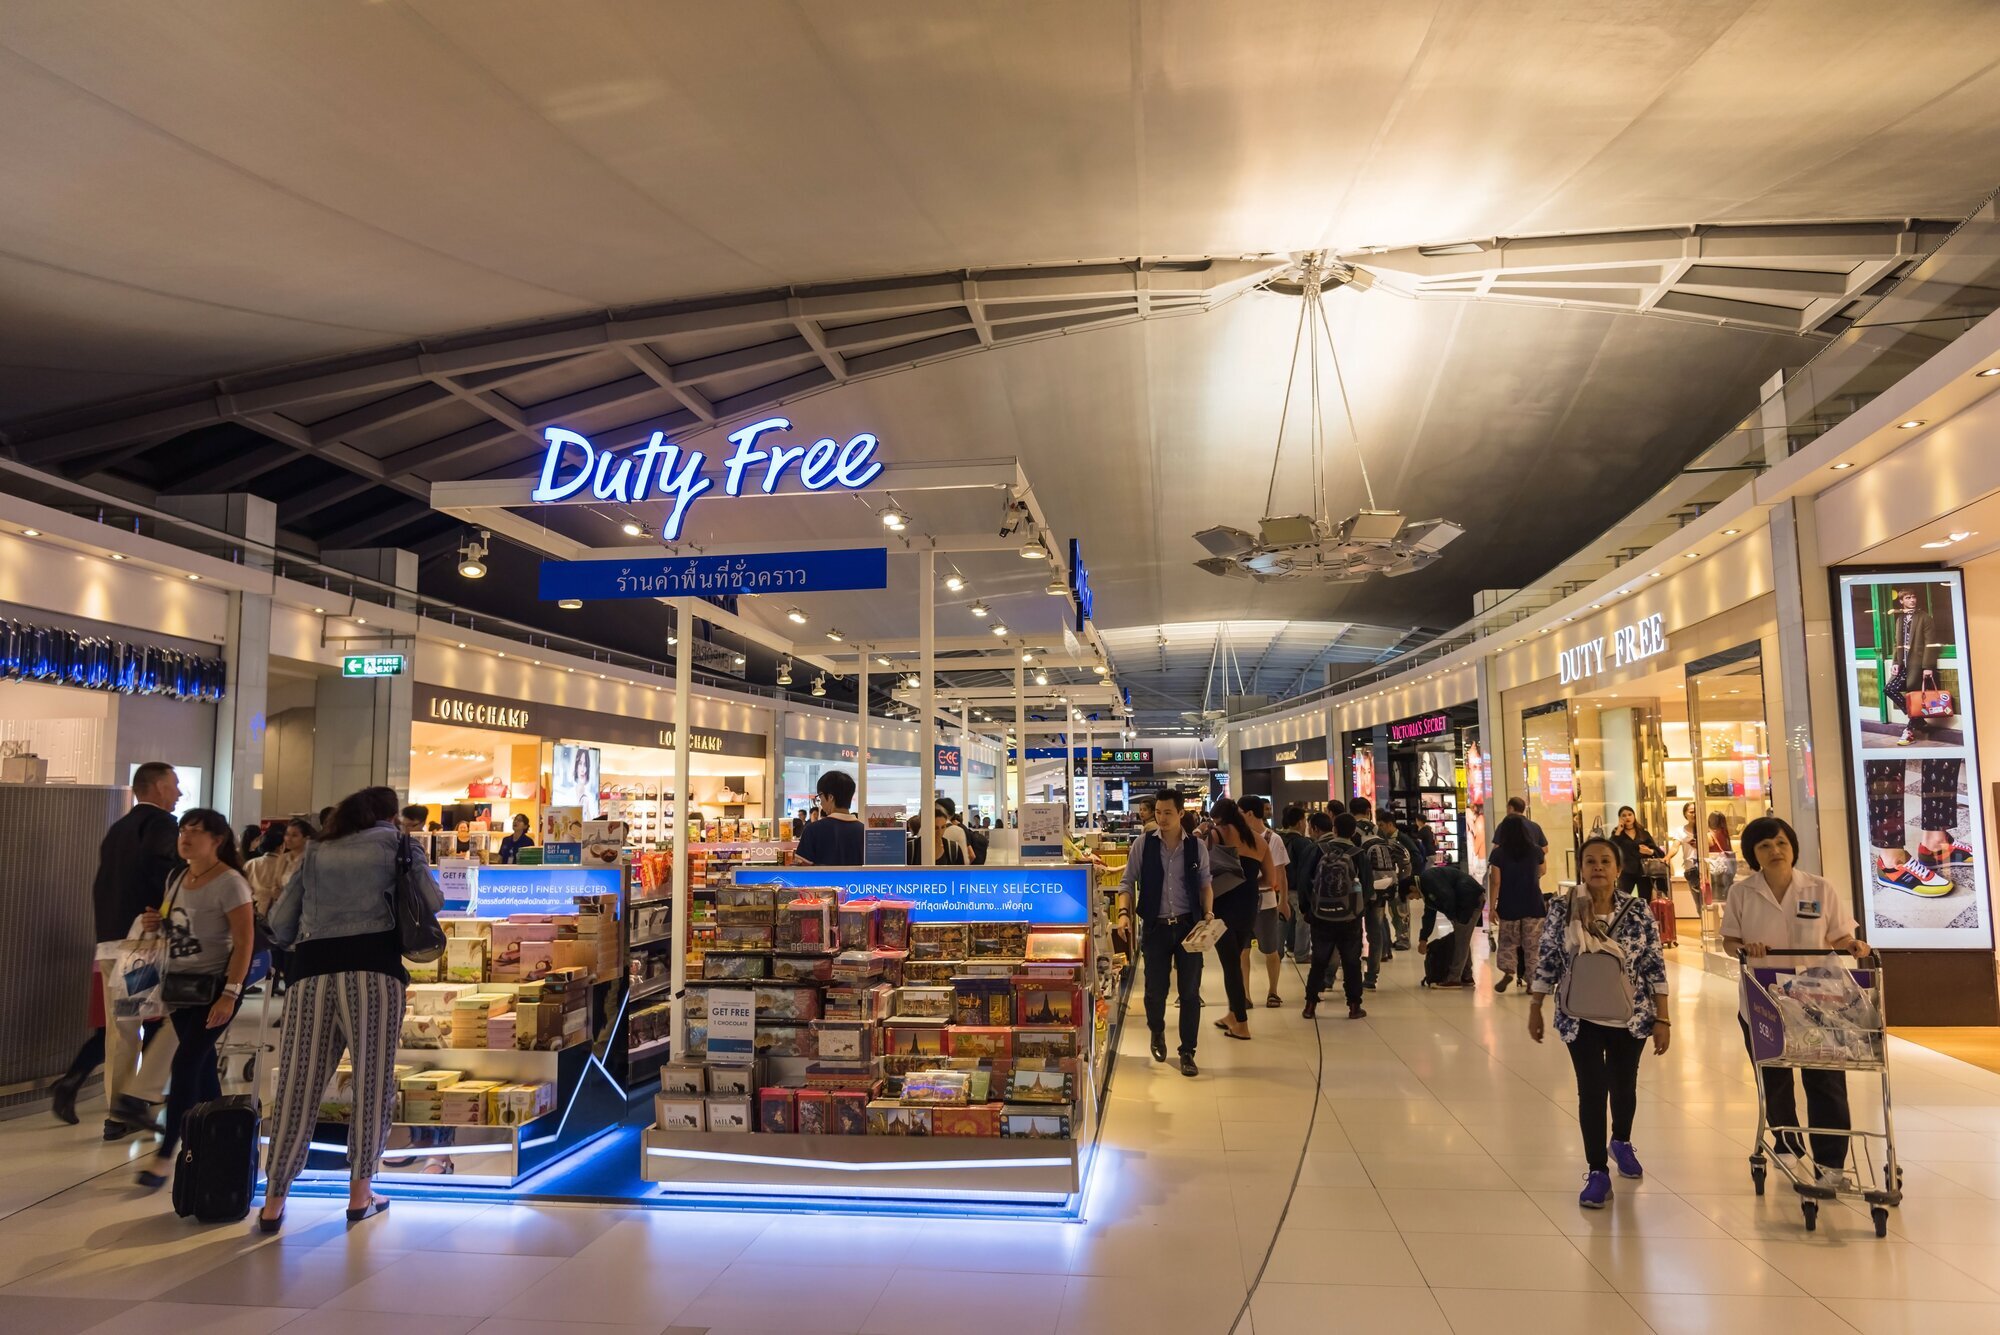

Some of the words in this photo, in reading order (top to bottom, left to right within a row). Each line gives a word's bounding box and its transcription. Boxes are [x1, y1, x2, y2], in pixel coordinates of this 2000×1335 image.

[531, 426, 716, 541] Duty
[722, 417, 887, 497] Free
[616, 559, 807, 592] ร้านค้าพื้นที่ชั่วคราว
[1560, 636, 1605, 685] DUTY
[1614, 612, 1665, 668] FREE
[376, 657, 399, 665] FIRE
[376, 665, 399, 673] EXIT
[430, 697, 529, 729] LONGCHAMP
[1391, 721, 1422, 740] VICTORIA'S
[1423, 715, 1447, 734] SECRET
[659, 730, 723, 751] LOCHAMP
[751, 847, 780, 856] FOOD
[442, 872, 456, 880] GET
[493, 885, 529, 894] INSPIRED
[536, 885, 562, 894] FINELY
[565, 885, 607, 894] SELECTED
[895, 883, 947, 894] INSPIRED
[959, 883, 998, 894] FINELY
[1002, 883, 1064, 894] SELECTED
[712, 1007, 728, 1016] GET
[731, 1008, 750, 1017] FREE
[668, 1117, 690, 1126] MILK
[714, 1118, 733, 1126] MILK
